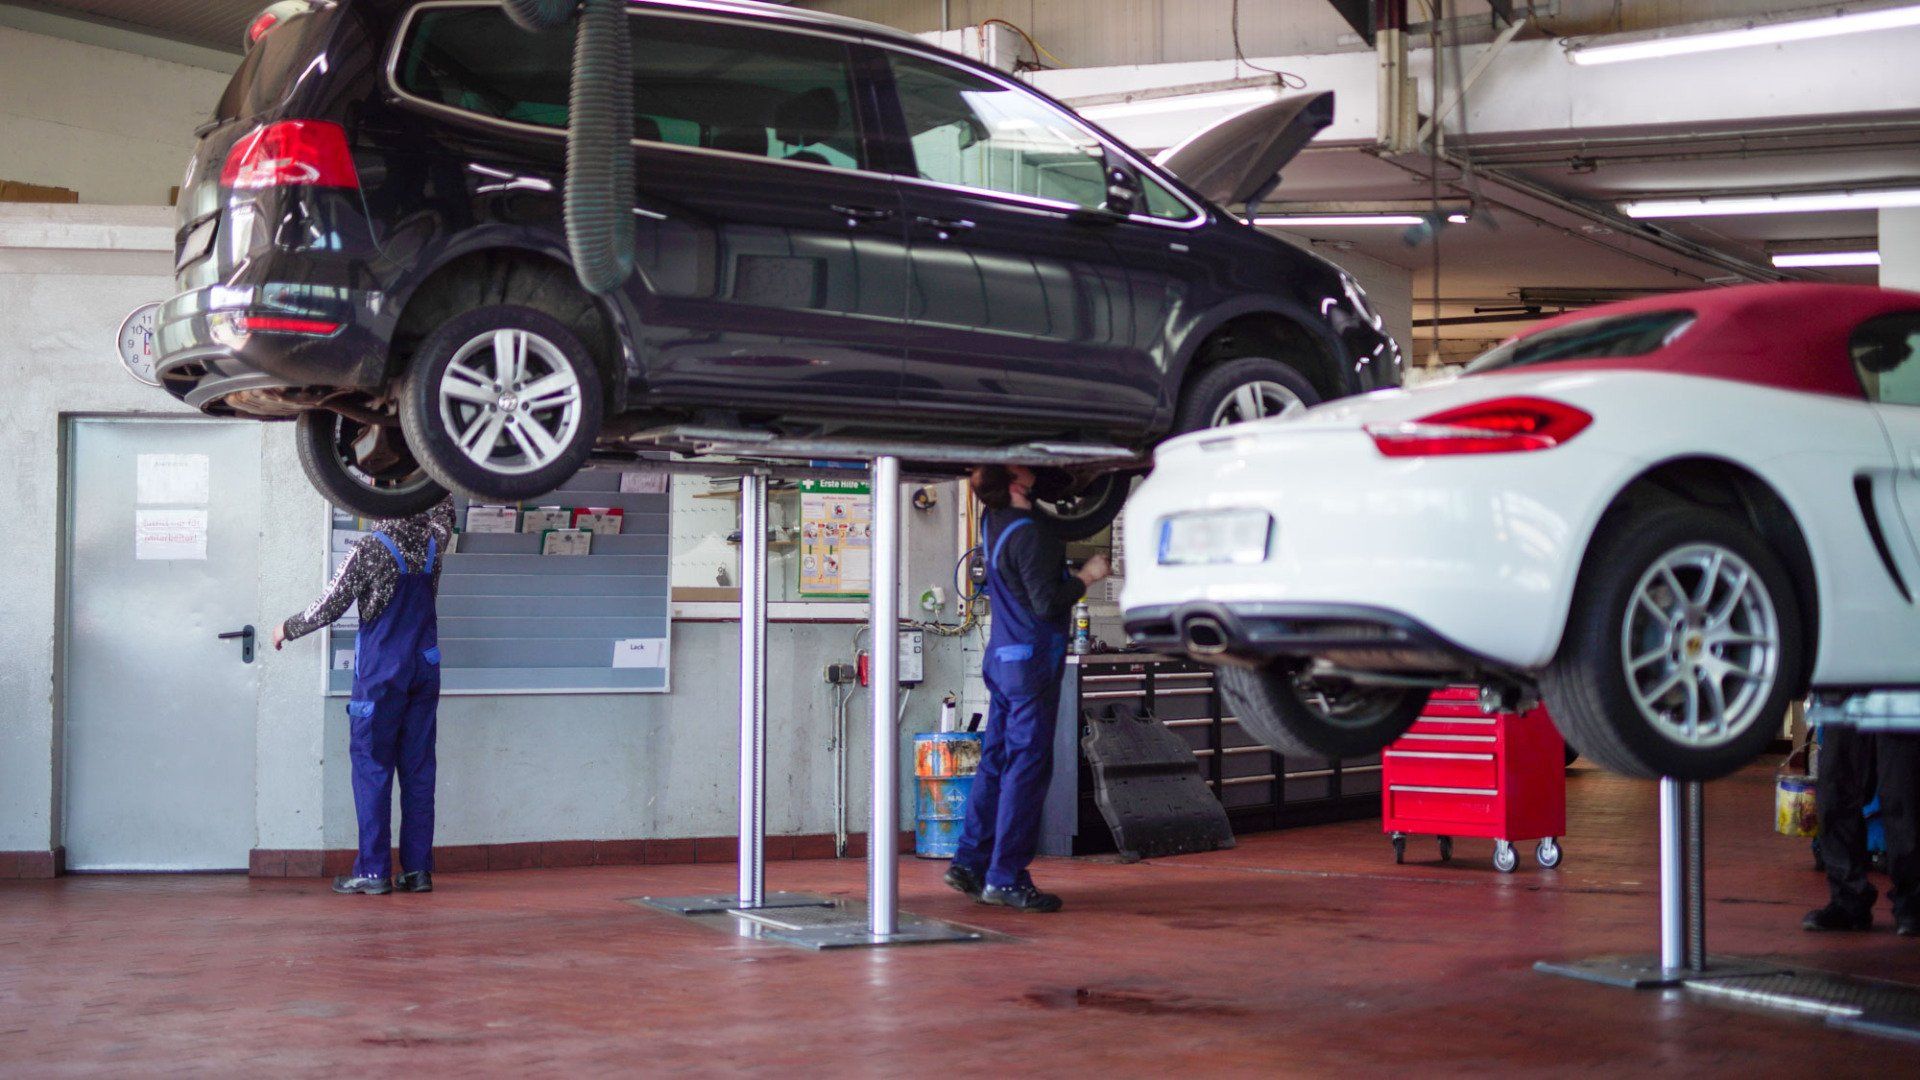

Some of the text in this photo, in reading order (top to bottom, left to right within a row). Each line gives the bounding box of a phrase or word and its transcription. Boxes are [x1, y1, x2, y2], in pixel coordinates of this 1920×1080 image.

[142, 315, 152, 324] 11
[131, 325, 143, 335] 10
[127, 339, 135, 348] 9
[132, 354, 139, 363] 8
[142, 364, 151, 373] 7
[820, 480, 840, 488] Erste
[841, 481, 859, 489] Hilfe
[630, 642, 645, 651] Lack
